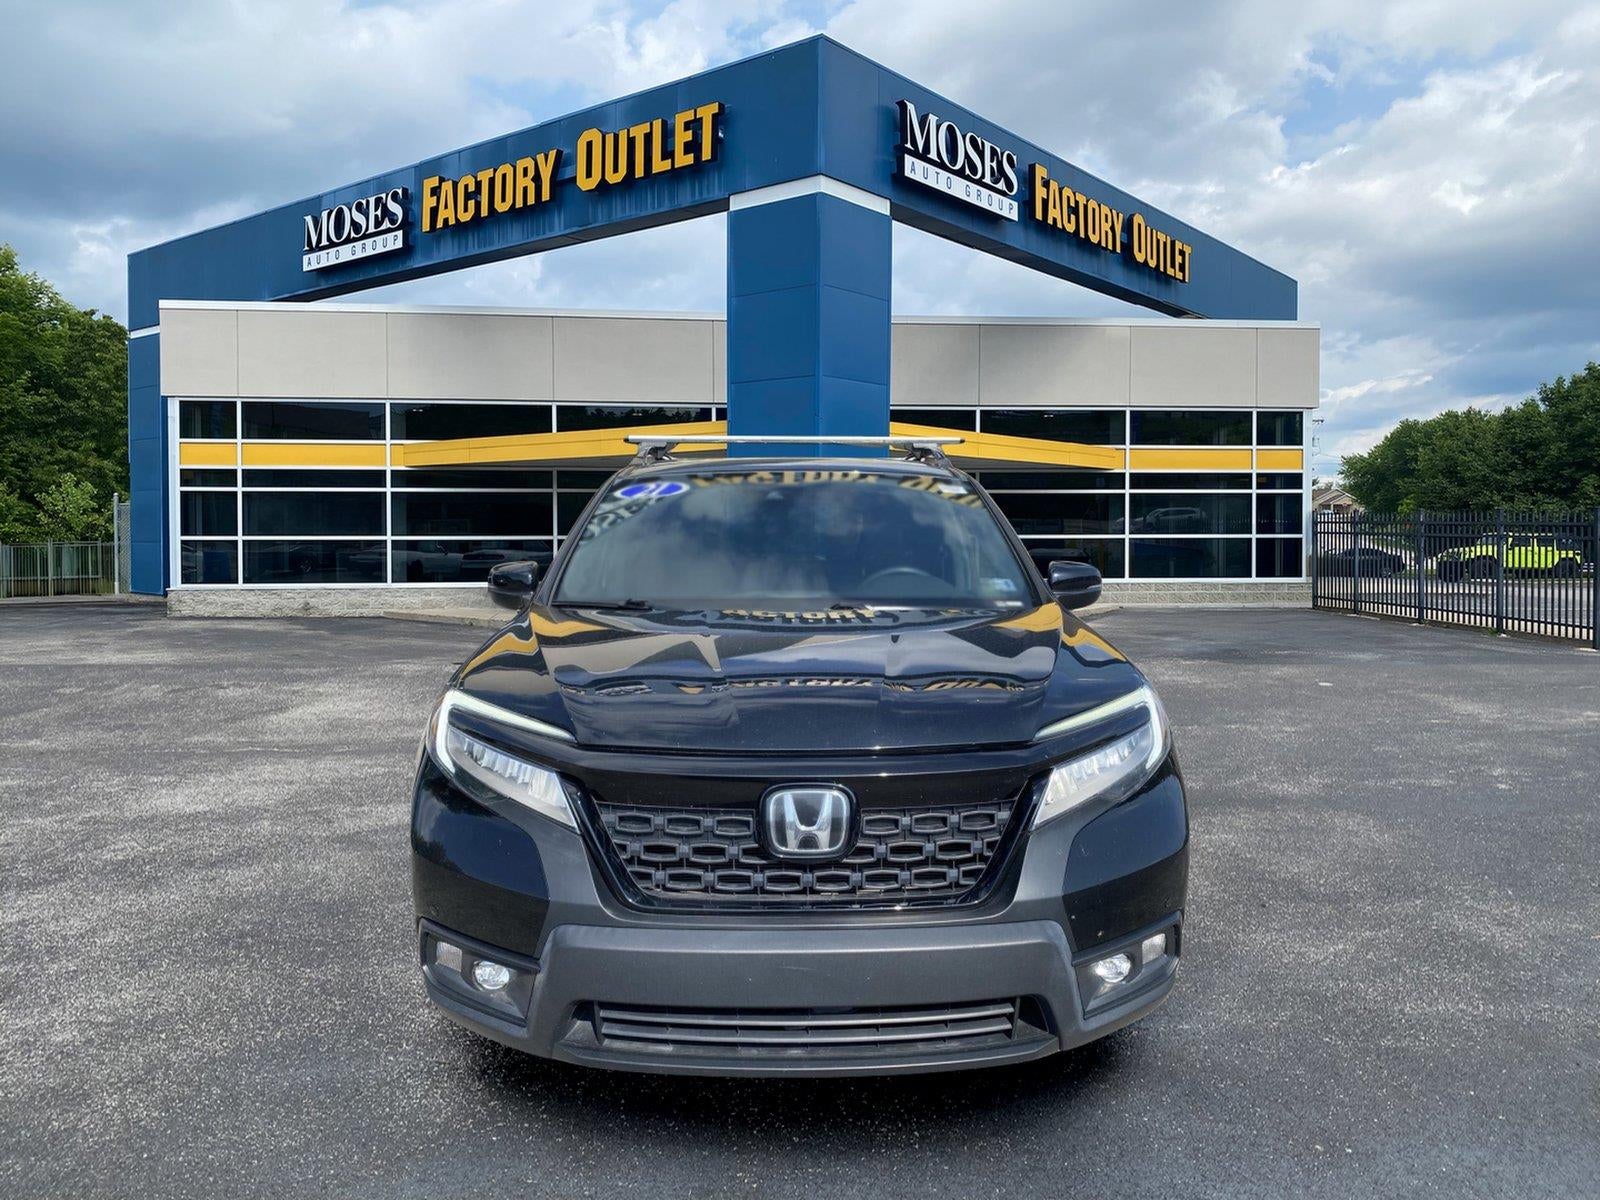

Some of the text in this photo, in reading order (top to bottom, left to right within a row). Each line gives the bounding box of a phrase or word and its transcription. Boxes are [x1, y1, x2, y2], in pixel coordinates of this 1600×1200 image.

[422, 101, 721, 233] FACTORY OUTLET
[904, 100, 1018, 196] MOSES
[909, 160, 1014, 214] AUTO GROUP
[303, 187, 404, 251] MOSES
[306, 234, 399, 268] AUTO GROUP
[1034, 163, 1192, 283] FACTORY OUTLET
